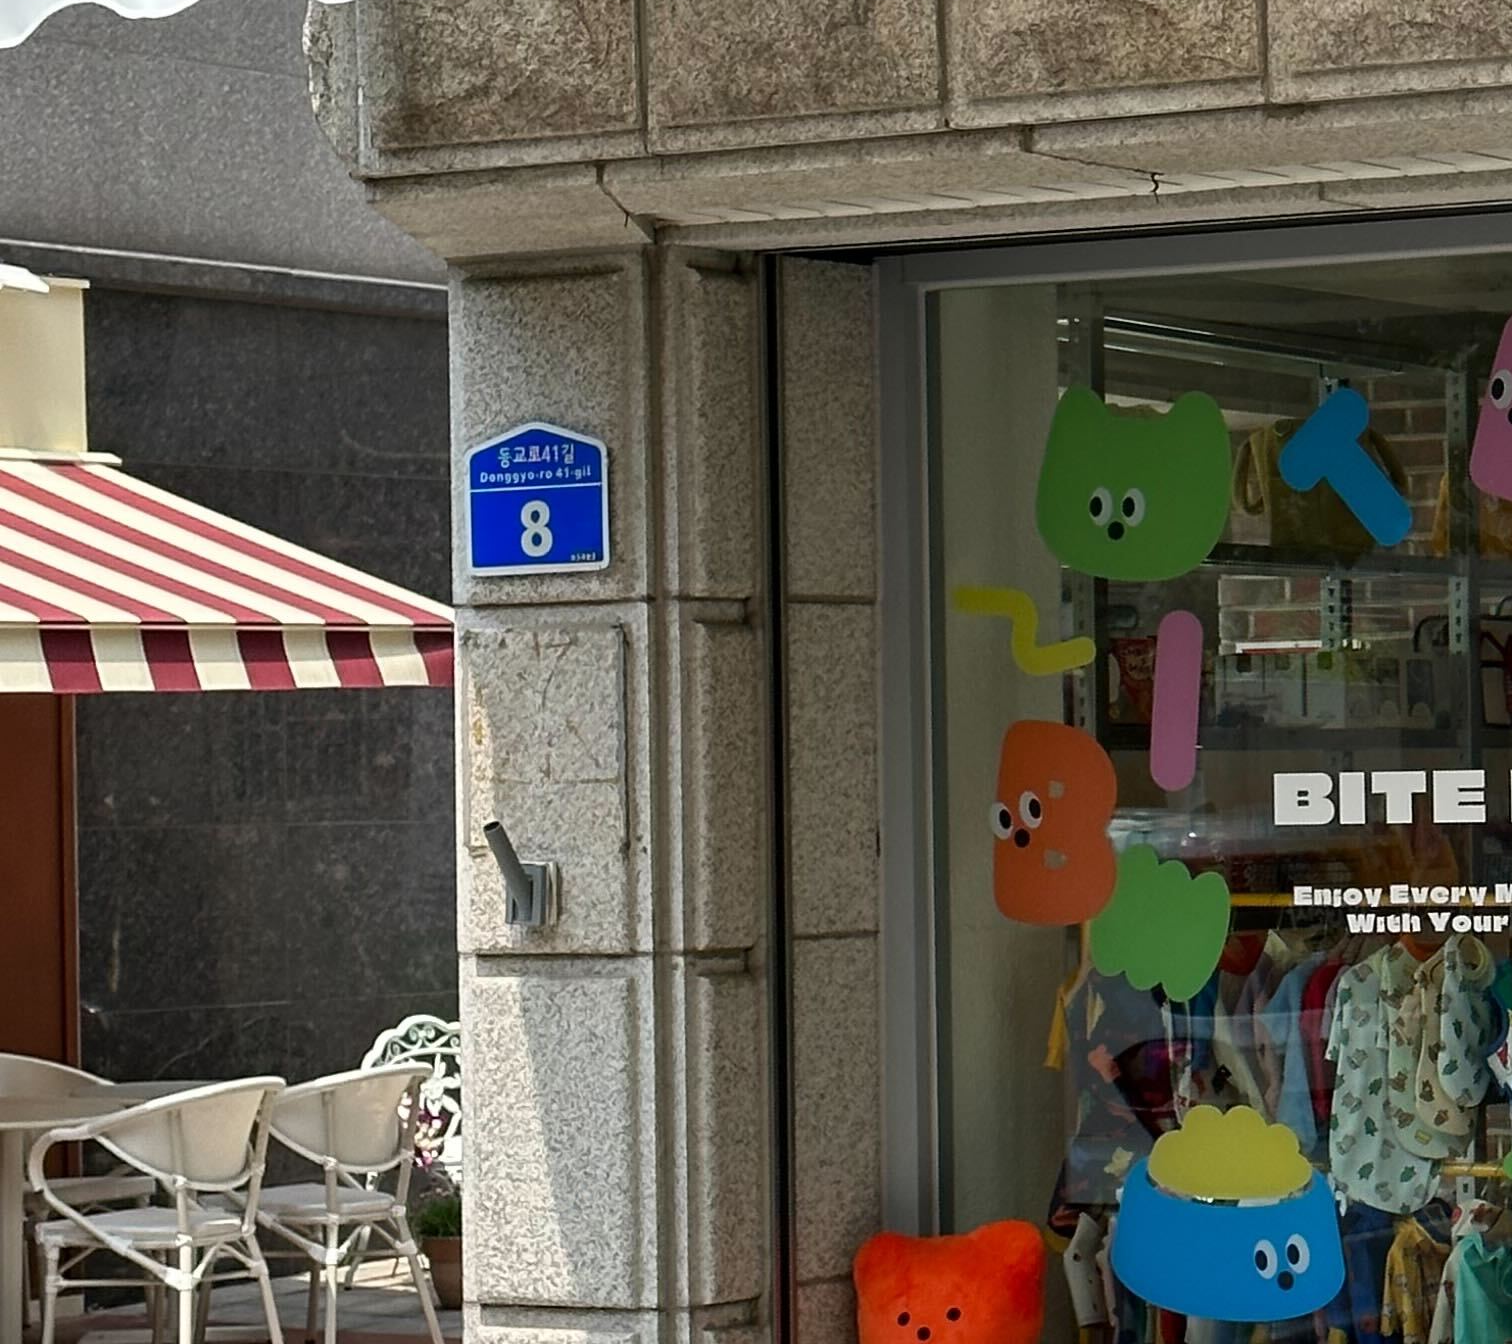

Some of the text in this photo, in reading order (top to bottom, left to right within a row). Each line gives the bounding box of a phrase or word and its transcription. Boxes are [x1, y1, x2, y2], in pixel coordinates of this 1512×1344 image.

[497, 443, 575, 468] 동교로41길
[480, 465, 591, 484] Donggyo-ro 41-gil
[520, 500, 553, 557] 8
[1273, 769, 1487, 826] BITE
[1293, 885, 1382, 909] Enjoy
[1389, 884, 1487, 906] Every
[1346, 913, 1422, 934] With
[1429, 912, 1510, 934] Your
